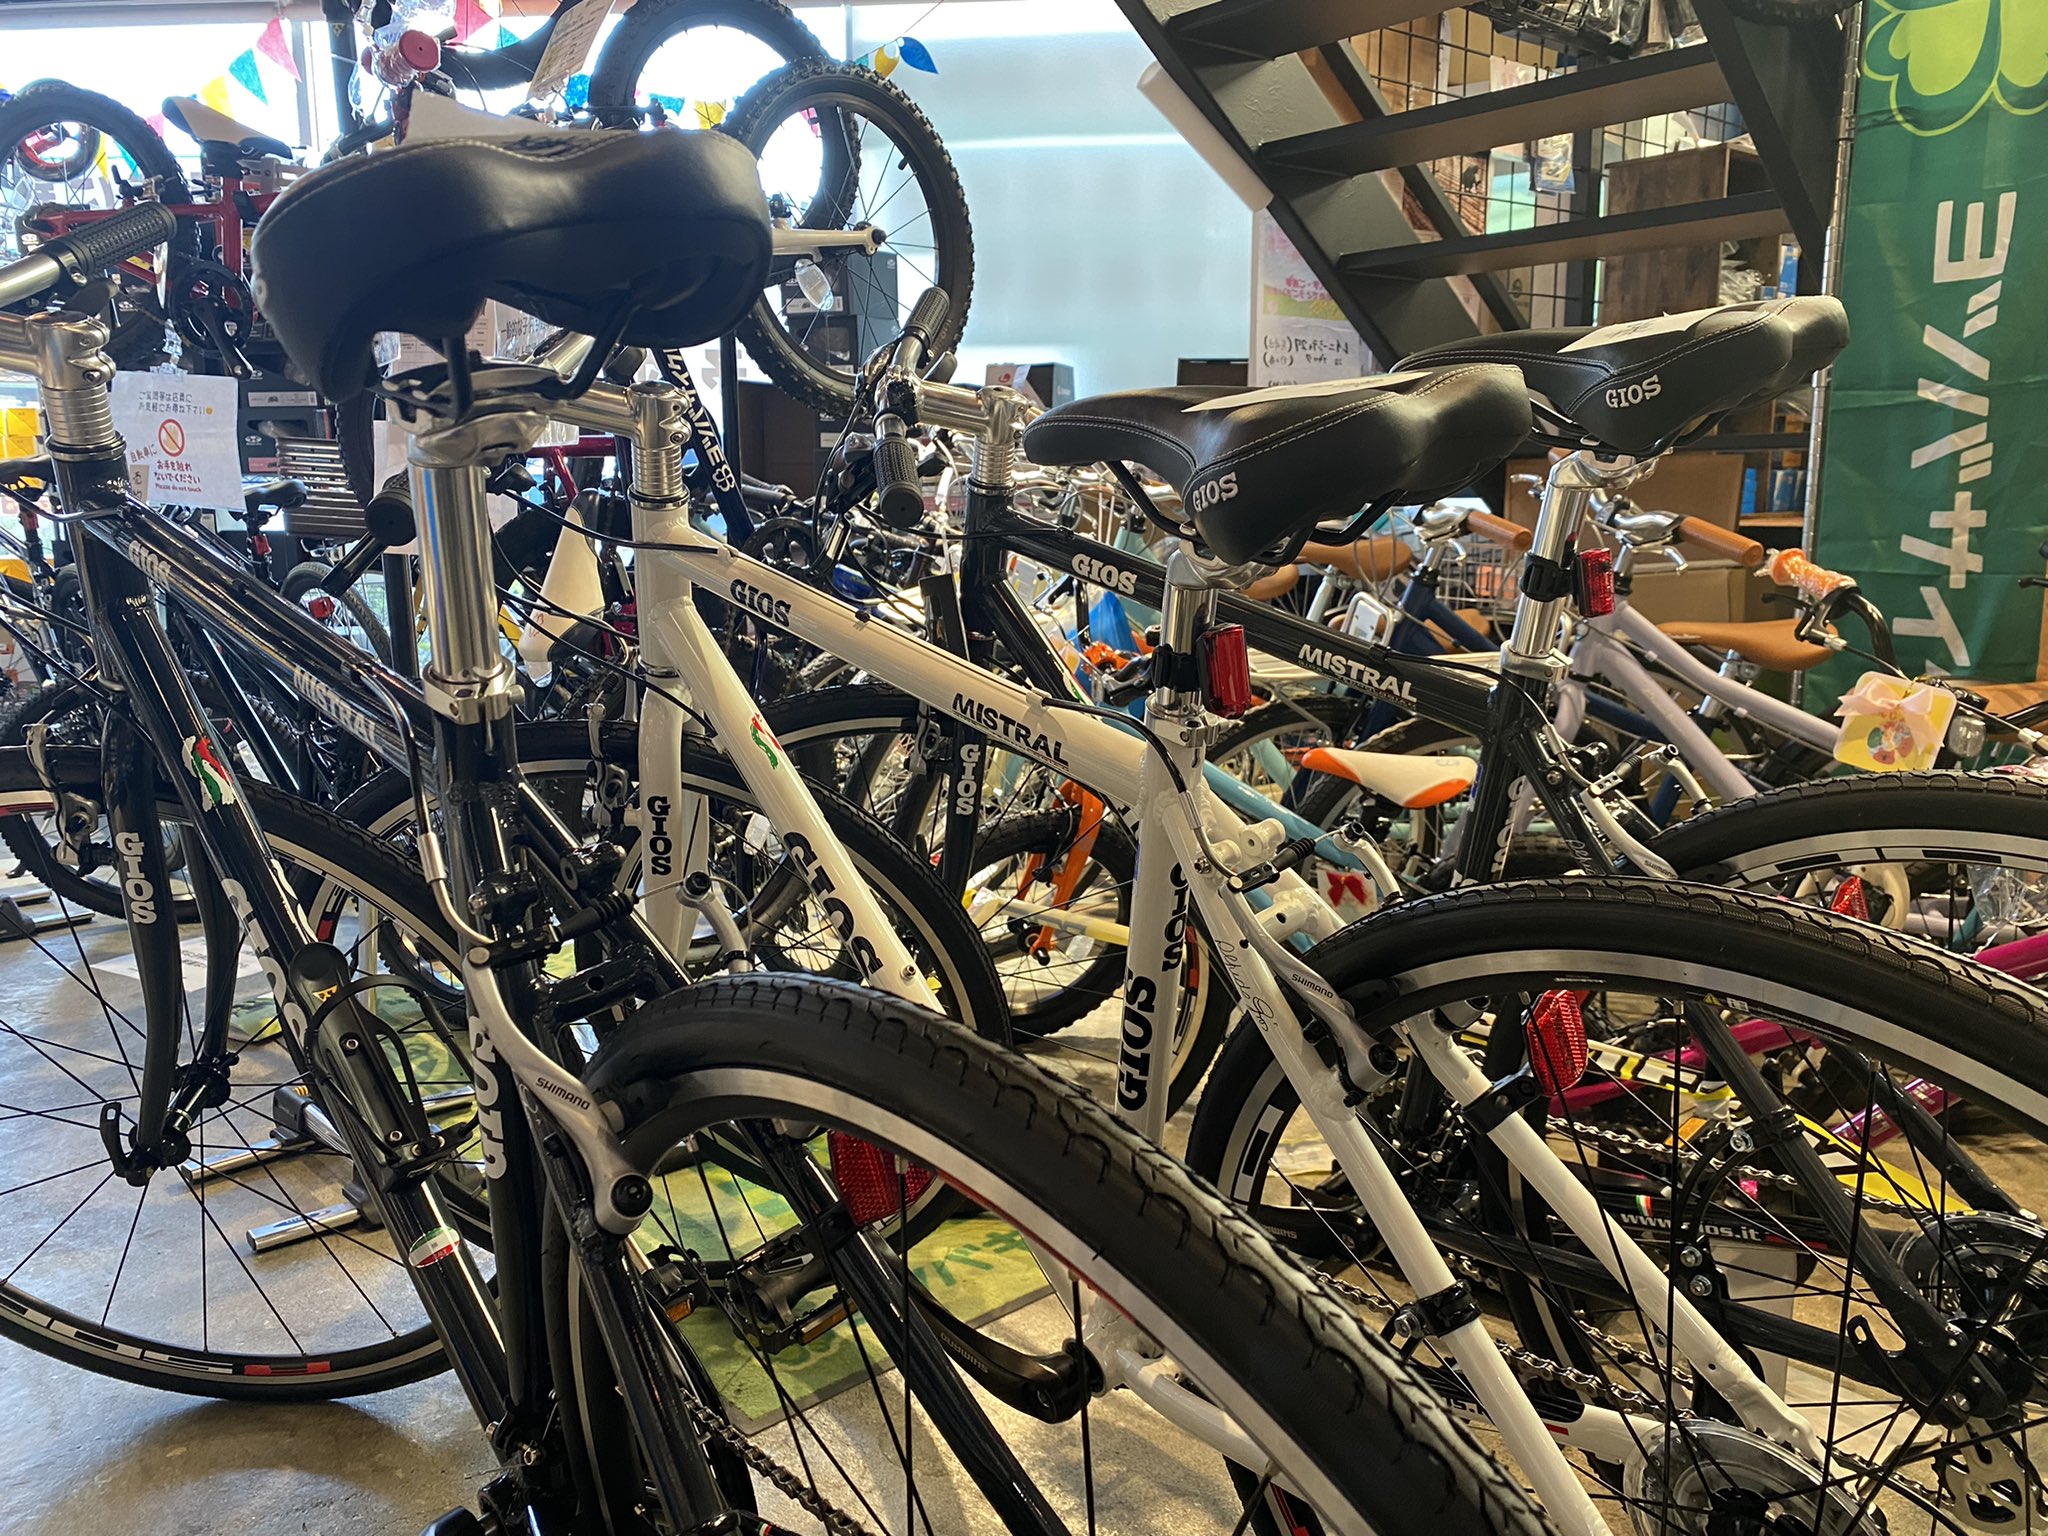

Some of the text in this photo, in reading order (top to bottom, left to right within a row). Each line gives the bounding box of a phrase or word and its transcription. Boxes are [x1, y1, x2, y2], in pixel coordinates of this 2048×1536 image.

[1604, 374, 1662, 409] GIOS
[1892, 191, 2017, 670] ヨツバサイ
[1193, 471, 1239, 513] GIOS
[729, 578, 793, 628] GIOS
[1070, 553, 1138, 596] GIOS
[1297, 643, 1418, 703] MISTRAL
[293, 666, 384, 753] MISTRAL
[951, 692, 1069, 767] MISTRAL
[955, 743, 981, 816] GIOS
[647, 795, 673, 876] GIOS
[115, 831, 158, 925] GIOS
[1291, 973, 1334, 999] SHIMANO
[1117, 968, 1158, 1112] GIOS
[535, 1076, 591, 1111] SHIMANO
[940, 1331, 989, 1374] SHIMANO
